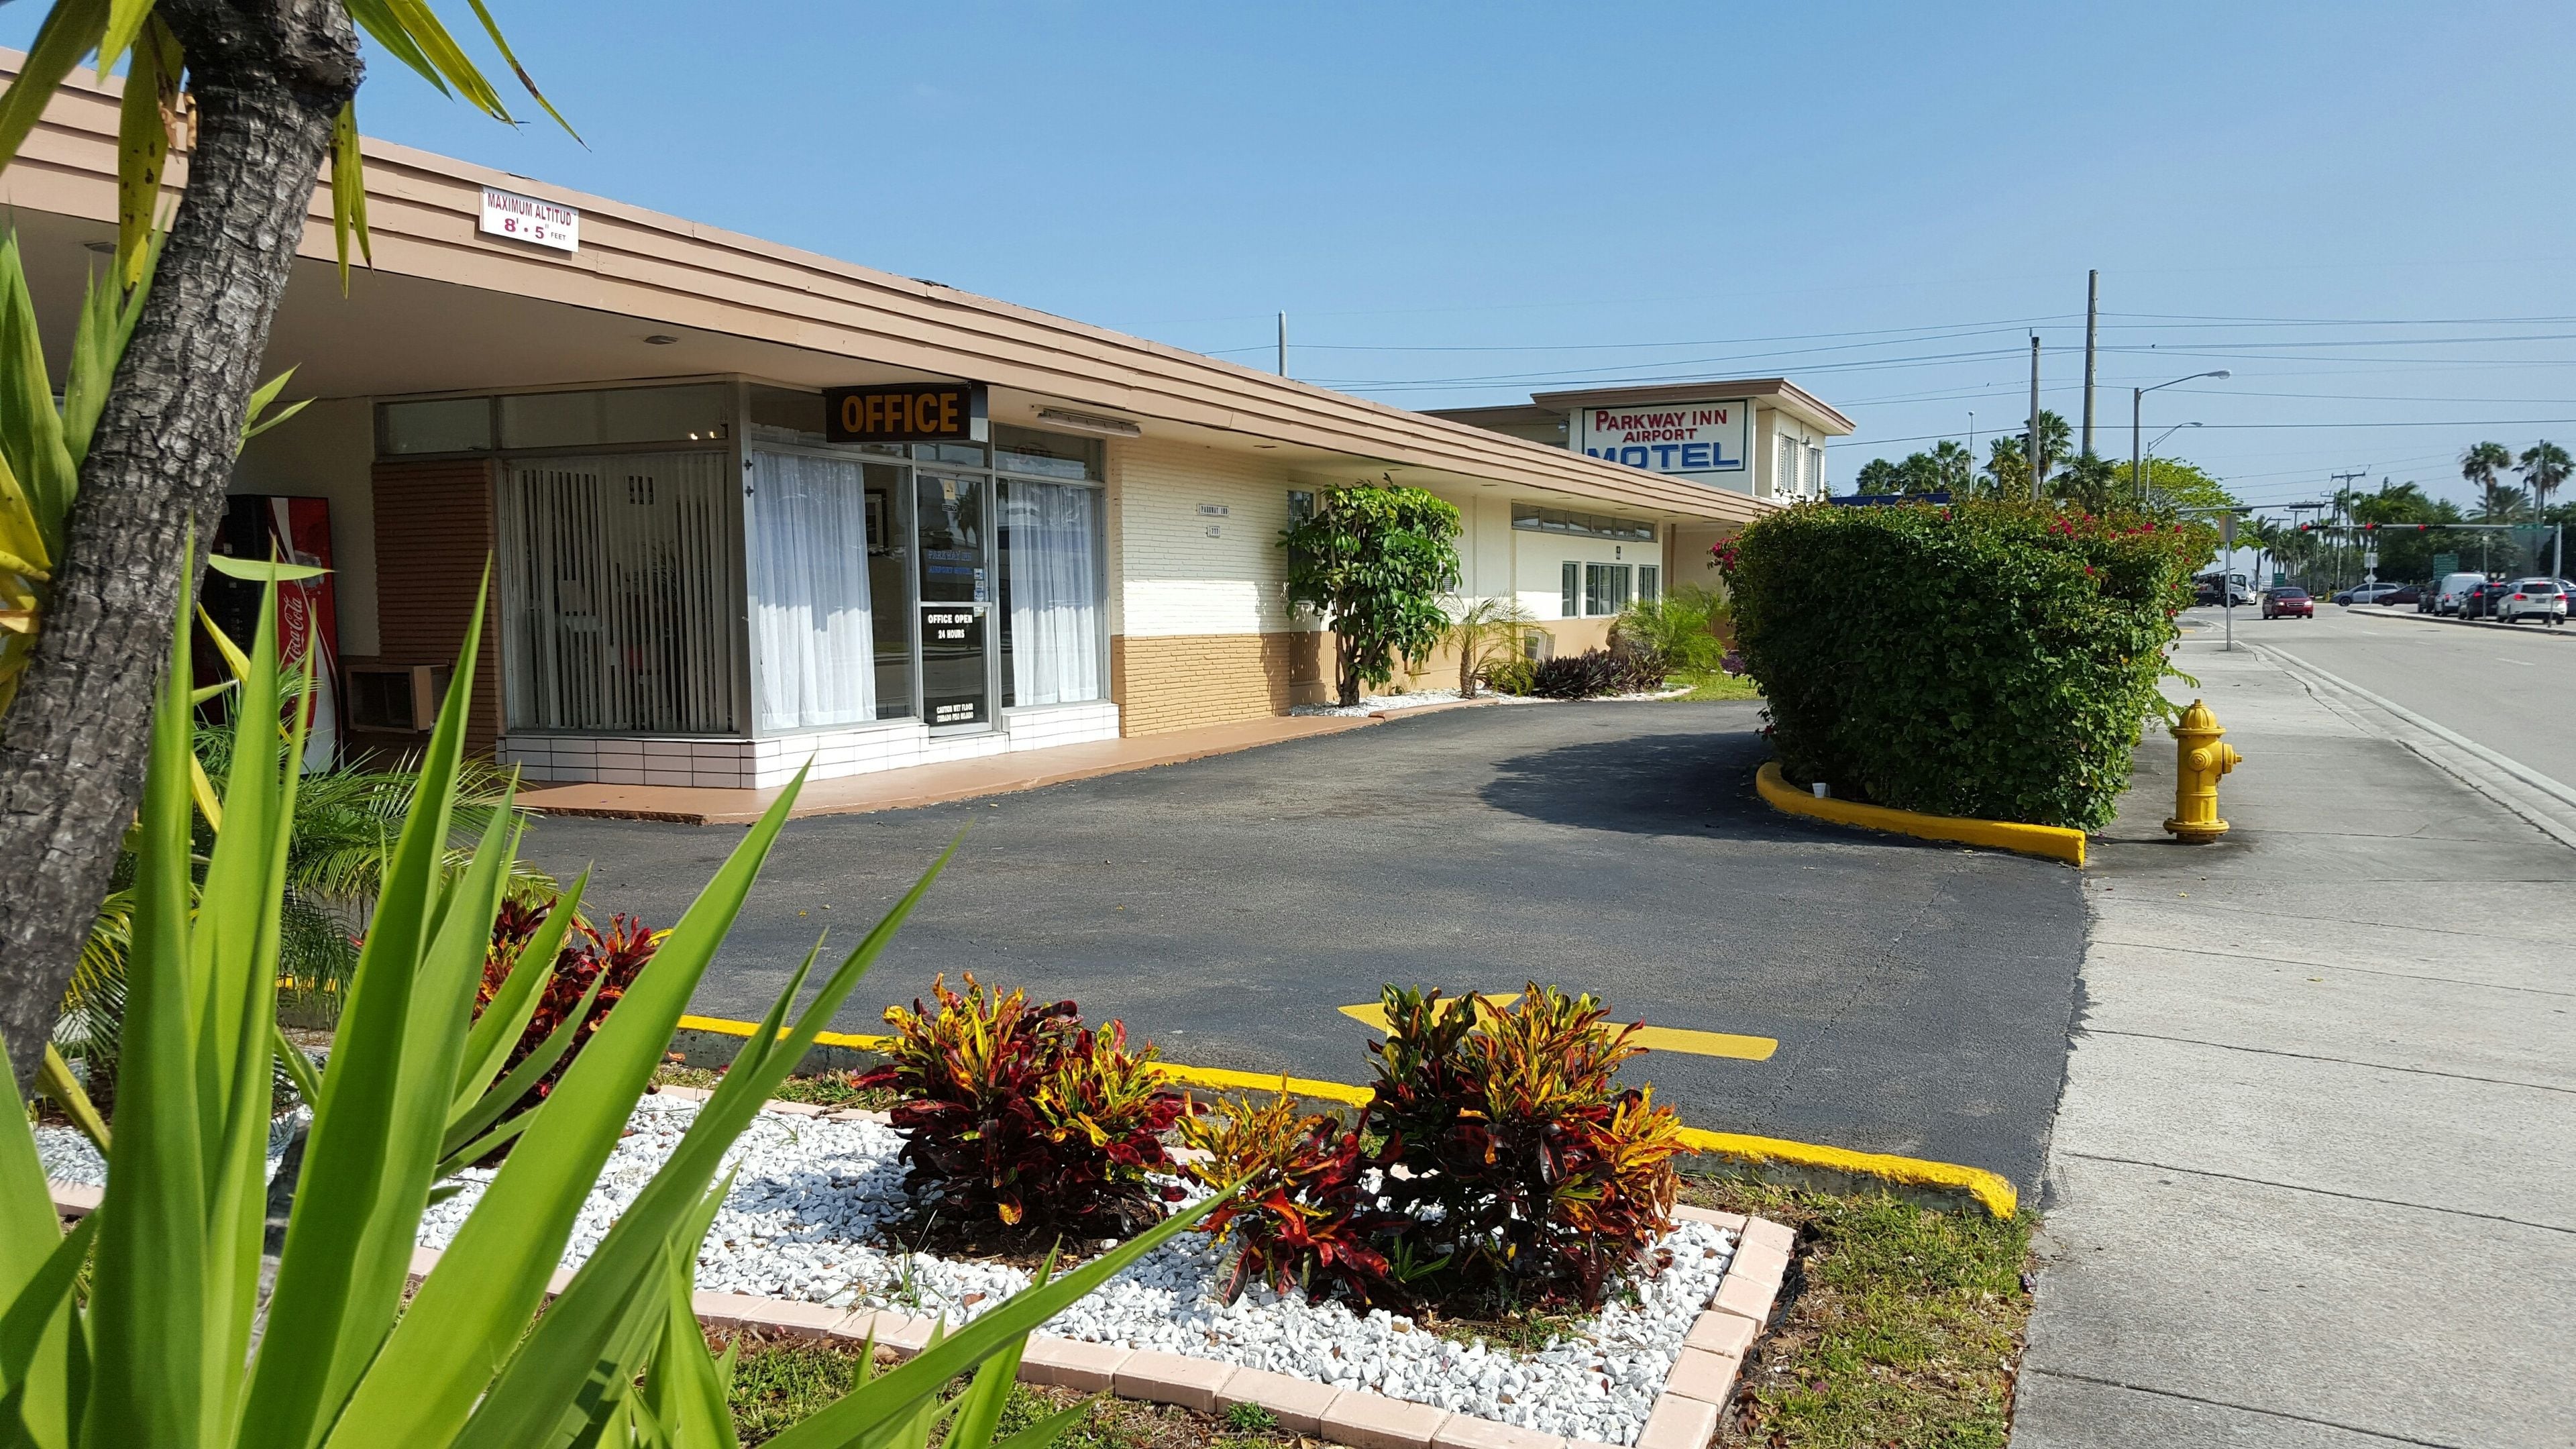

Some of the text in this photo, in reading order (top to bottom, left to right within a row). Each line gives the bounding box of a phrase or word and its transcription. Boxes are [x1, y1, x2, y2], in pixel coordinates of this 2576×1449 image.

[488, 193, 572, 226] MAXIMUM ALTITUD
[551, 232, 566, 241] FEET
[842, 393, 958, 433] OFFICE
[1595, 409, 1727, 432] PARKWAY INN
[1622, 428, 1698, 443] AIRPORT
[1587, 442, 1739, 470] MOTEL
[928, 549, 961, 560] PARKWAY
[928, 614, 973, 624] OFFICE OPEN
[938, 629, 965, 639] 24 HOURS
[936, 703, 973, 714] CAUTION WET FLOOR
[952, 712, 960, 721] PISO
[960, 711, 974, 720] MOJADO
